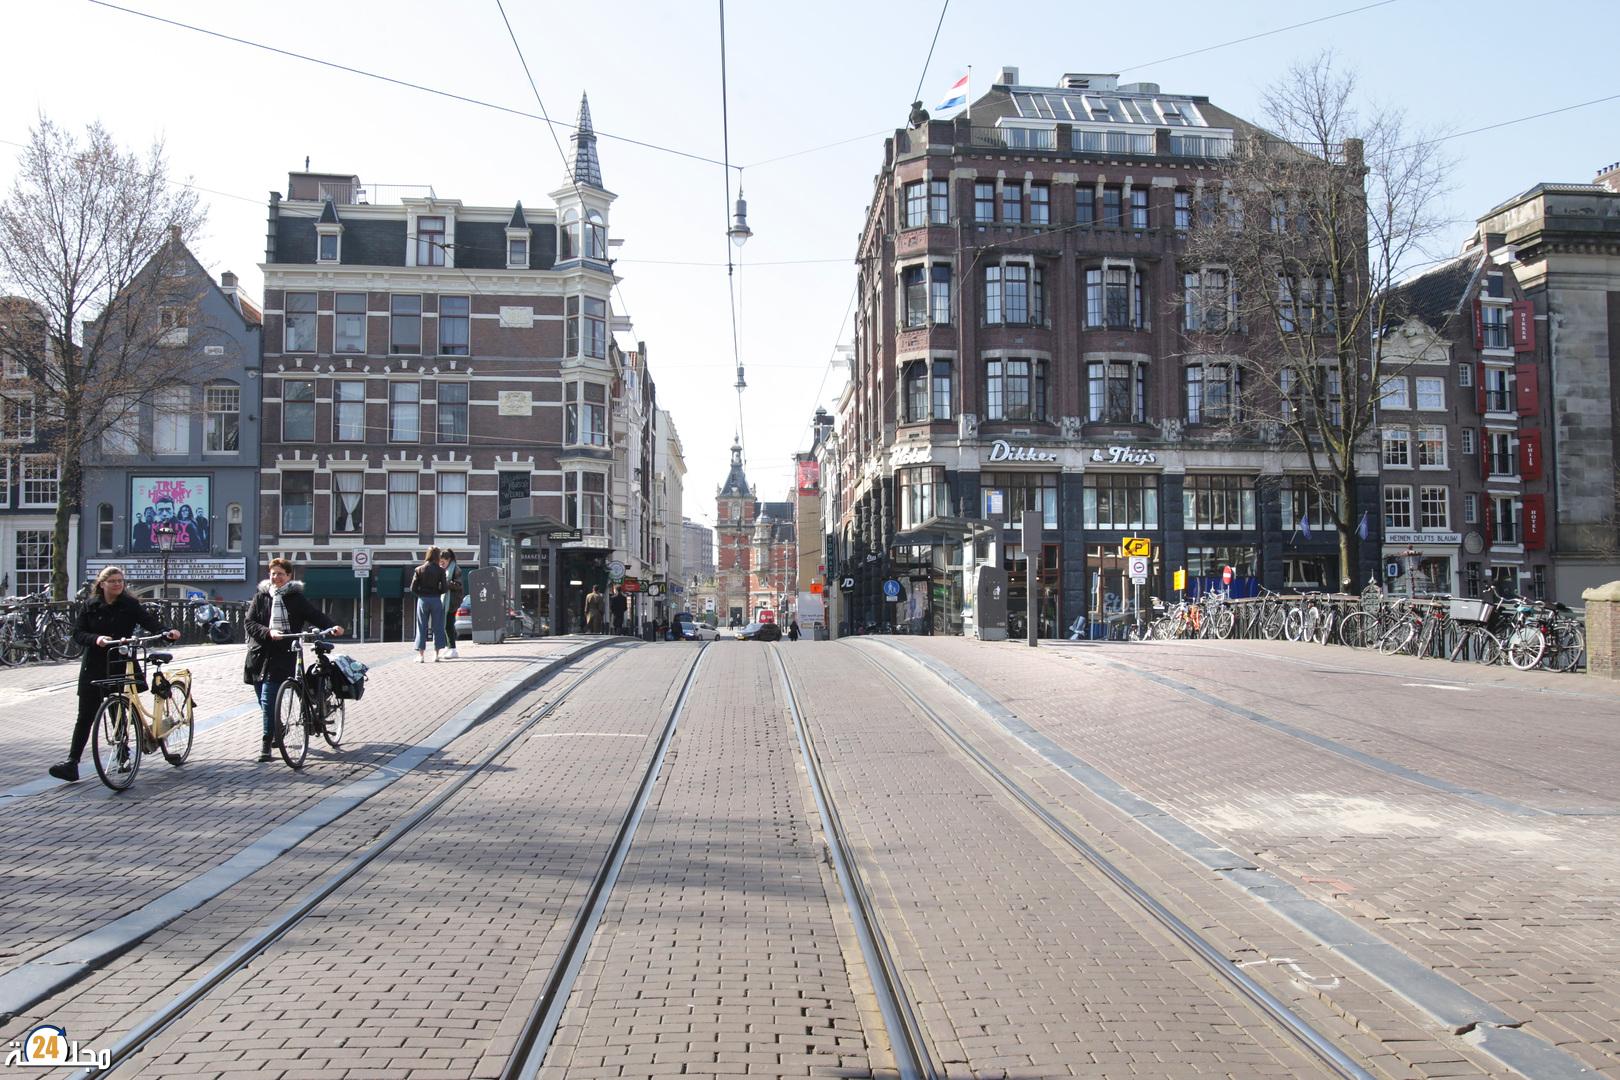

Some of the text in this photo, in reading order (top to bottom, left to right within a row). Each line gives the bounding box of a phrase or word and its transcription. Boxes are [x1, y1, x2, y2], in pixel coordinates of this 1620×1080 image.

[889, 444, 932, 465] Hotel
[989, 439, 1156, 466] Dikker & Thijs
[155, 480, 186, 490] TRUE
[148, 488, 192, 499] HISTORY
[1389, 534, 1458, 542] HEINEN DELFTS BLAUW
[1134, 542, 1143, 553] P
[841, 577, 855, 588] JD
